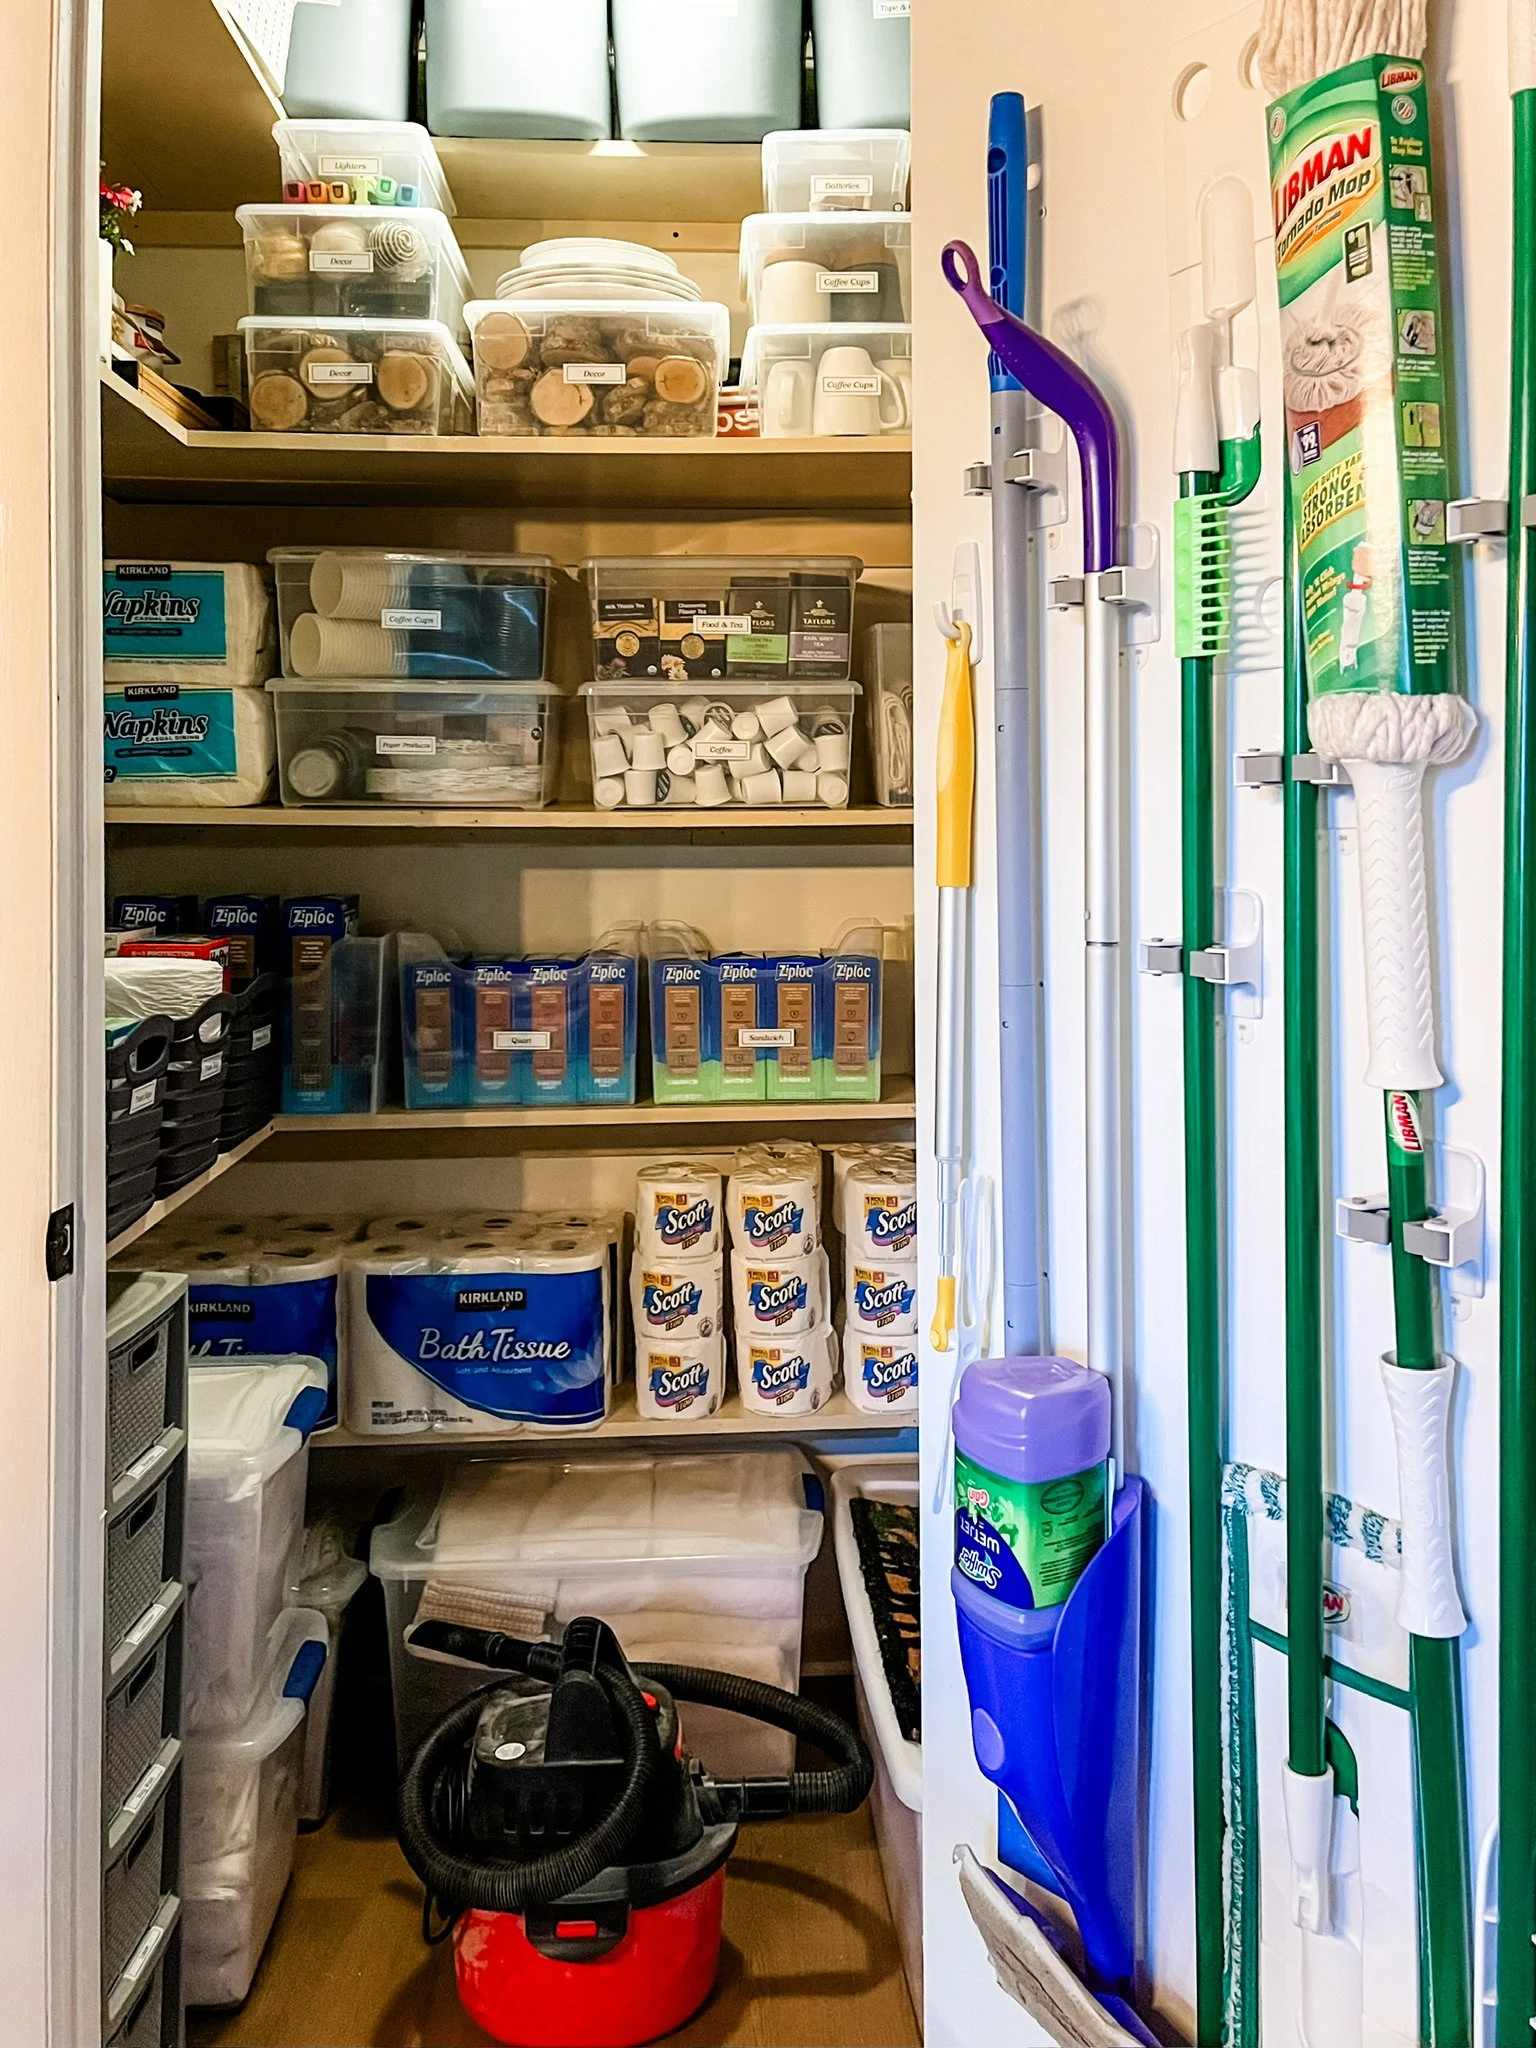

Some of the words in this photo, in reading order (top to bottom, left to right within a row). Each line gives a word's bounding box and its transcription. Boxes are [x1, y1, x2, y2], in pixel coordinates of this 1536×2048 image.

[1382, 71, 1418, 89] LIBMAN
[334, 161, 367, 172] Lighters
[825, 181, 859, 190] Batteries
[1275, 126, 1372, 240] LIBMAN
[1328, 169, 1371, 207] Mop
[330, 257, 352, 266] Decor
[823, 277, 848, 288] Coffee
[850, 277, 870, 288] Cups
[329, 368, 352, 377] Decor
[583, 369, 605, 378] Decor
[827, 380, 851, 391] Coffee
[853, 380, 873, 391] Cups
[1303, 471, 1352, 523] STRONG
[1301, 482, 1366, 544] ABSORBEN
[119, 566, 168, 575] KIRKLAND
[389, 615, 412, 625] Coffee
[414, 615, 434, 625] Cups
[701, 620, 719, 629] Food
[731, 620, 743, 629] Tea
[752, 619, 775, 627] YLORS
[803, 617, 836, 626] TAYLORS
[128, 686, 176, 695] KIRKLAND
[104, 709, 208, 745] Napkins
[710, 745, 733, 755] Coffee
[124, 907, 166, 924] Ziploc
[216, 908, 258, 926] Ziploc
[293, 908, 335, 927] Ziploc
[416, 969, 451, 986] Ziploc
[477, 968, 512, 985] Ziploc
[532, 967, 568, 984] Ziploc
[590, 965, 626, 982] Ziploc
[666, 967, 701, 983] Ziploc
[722, 965, 758, 982] Ziploc
[778, 964, 813, 981] Ziploc
[835, 963, 871, 980] Ziploc
[749, 1033, 784, 1042] Sandwich
[1392, 1094, 1423, 1151] LIBMAN
[665, 1200, 707, 1234] Scott
[752, 1202, 794, 1236] Scott
[876, 1203, 916, 1236] Scott
[459, 1291, 524, 1304] KIRKLAND
[650, 1283, 692, 1314] Scott
[758, 1277, 799, 1310] Scott
[862, 1280, 905, 1310] Scott
[419, 1327, 490, 1361] Bath
[490, 1328, 571, 1362] Tissue
[760, 1357, 801, 1389] Scott
[871, 1353, 914, 1387] Scott
[659, 1364, 701, 1396] Scott
[959, 1547, 1002, 1589] Swiffer
